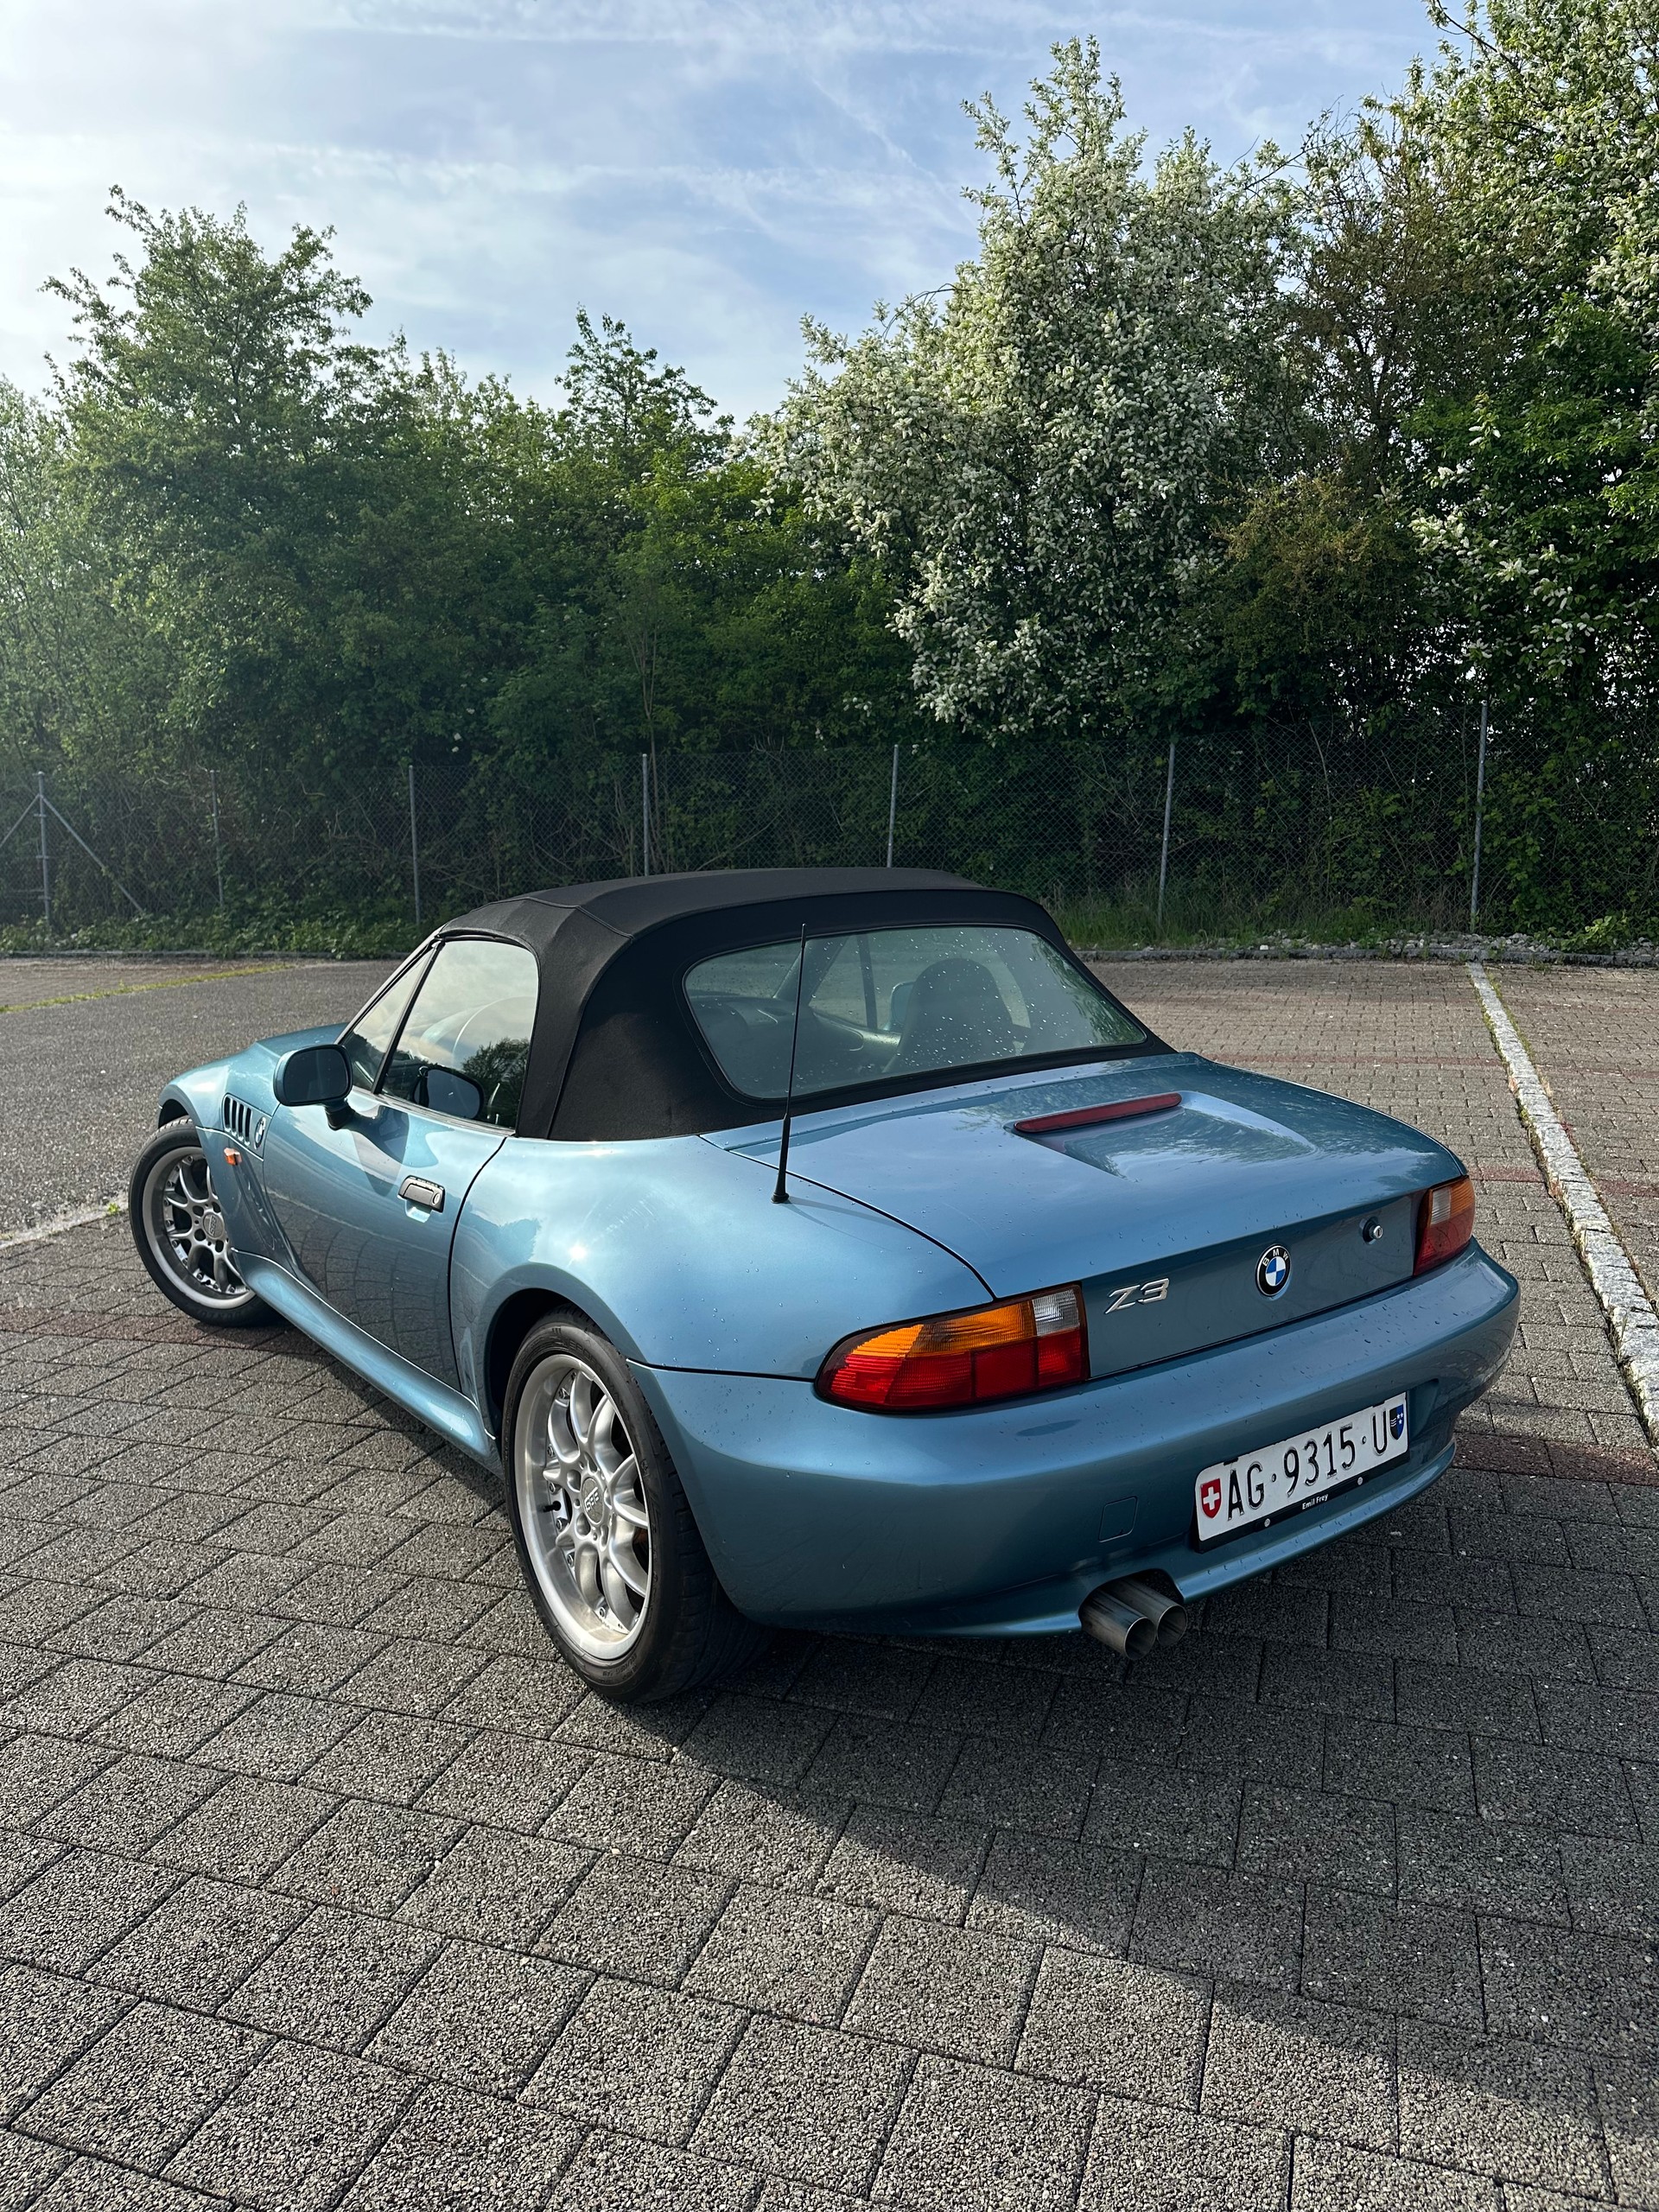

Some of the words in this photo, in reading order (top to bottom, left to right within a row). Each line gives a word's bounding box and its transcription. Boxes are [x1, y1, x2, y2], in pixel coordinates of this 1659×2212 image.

[1262, 1249, 1288, 1267] BMW
[1105, 1278, 1170, 1314] Z3
[585, 1487, 599, 1512] BBS
[1302, 1498, 1315, 1510] Emil
[1316, 1494, 1329, 1503] Frey
